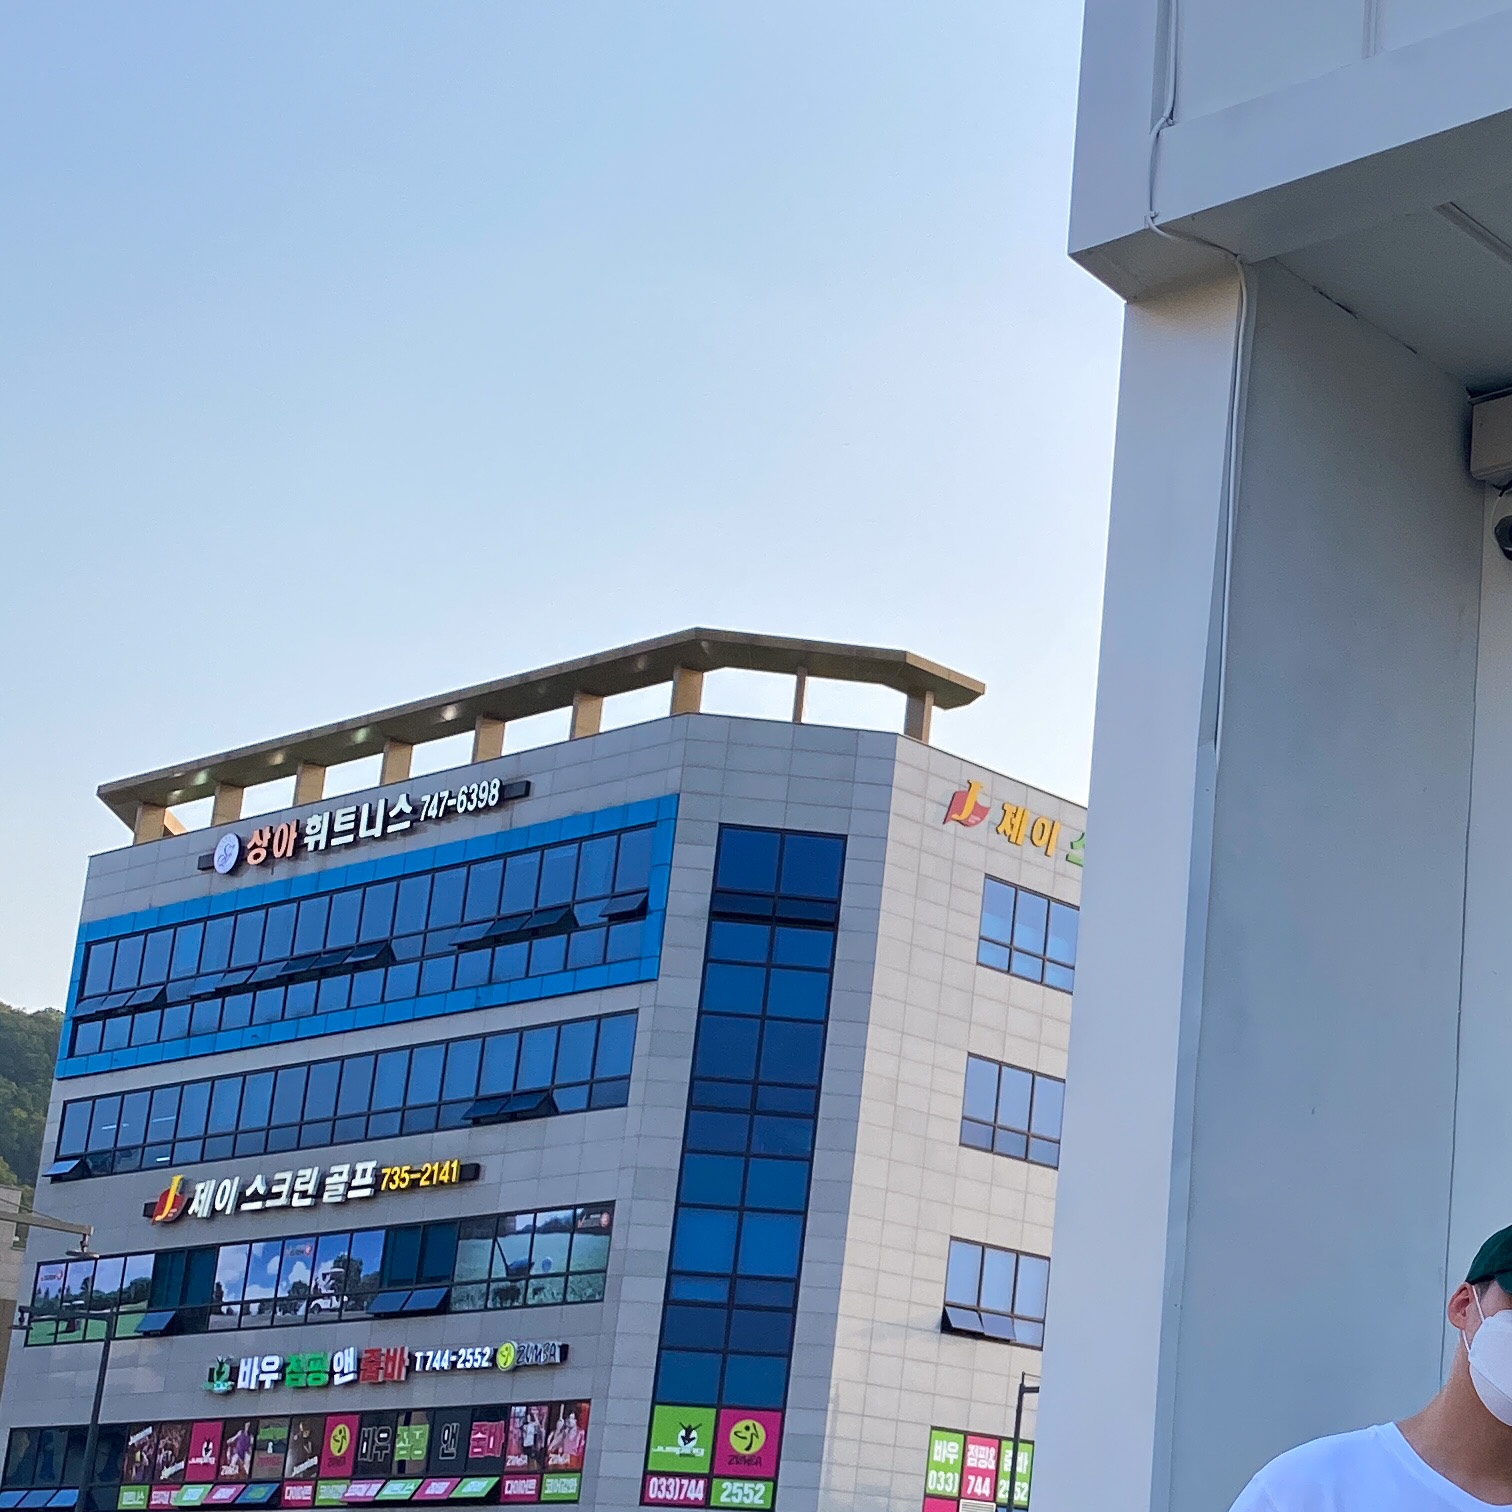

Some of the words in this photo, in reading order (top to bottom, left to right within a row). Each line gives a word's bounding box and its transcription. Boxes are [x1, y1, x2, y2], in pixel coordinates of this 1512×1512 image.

[246, 818, 300, 865] 상아
[303, 792, 413, 852] 휘트니스
[420, 777, 502, 821] 747-6398
[996, 801, 1062, 857] 제이
[188, 1176, 239, 1218] 제이
[240, 1165, 320, 1212] 스크린
[322, 1160, 378, 1203] 골프
[380, 1159, 460, 1191] 735-2141
[237, 1354, 283, 1390] 바우
[332, 1347, 358, 1386] 앤
[516, 1341, 561, 1366] ZUMBA
[933, 1440, 959, 1465] 바우
[649, 1477, 705, 1501] 033)744
[720, 1481, 766, 1504] 2552
[927, 1469, 959, 1494] 033)
[966, 1475, 991, 1497] 744
